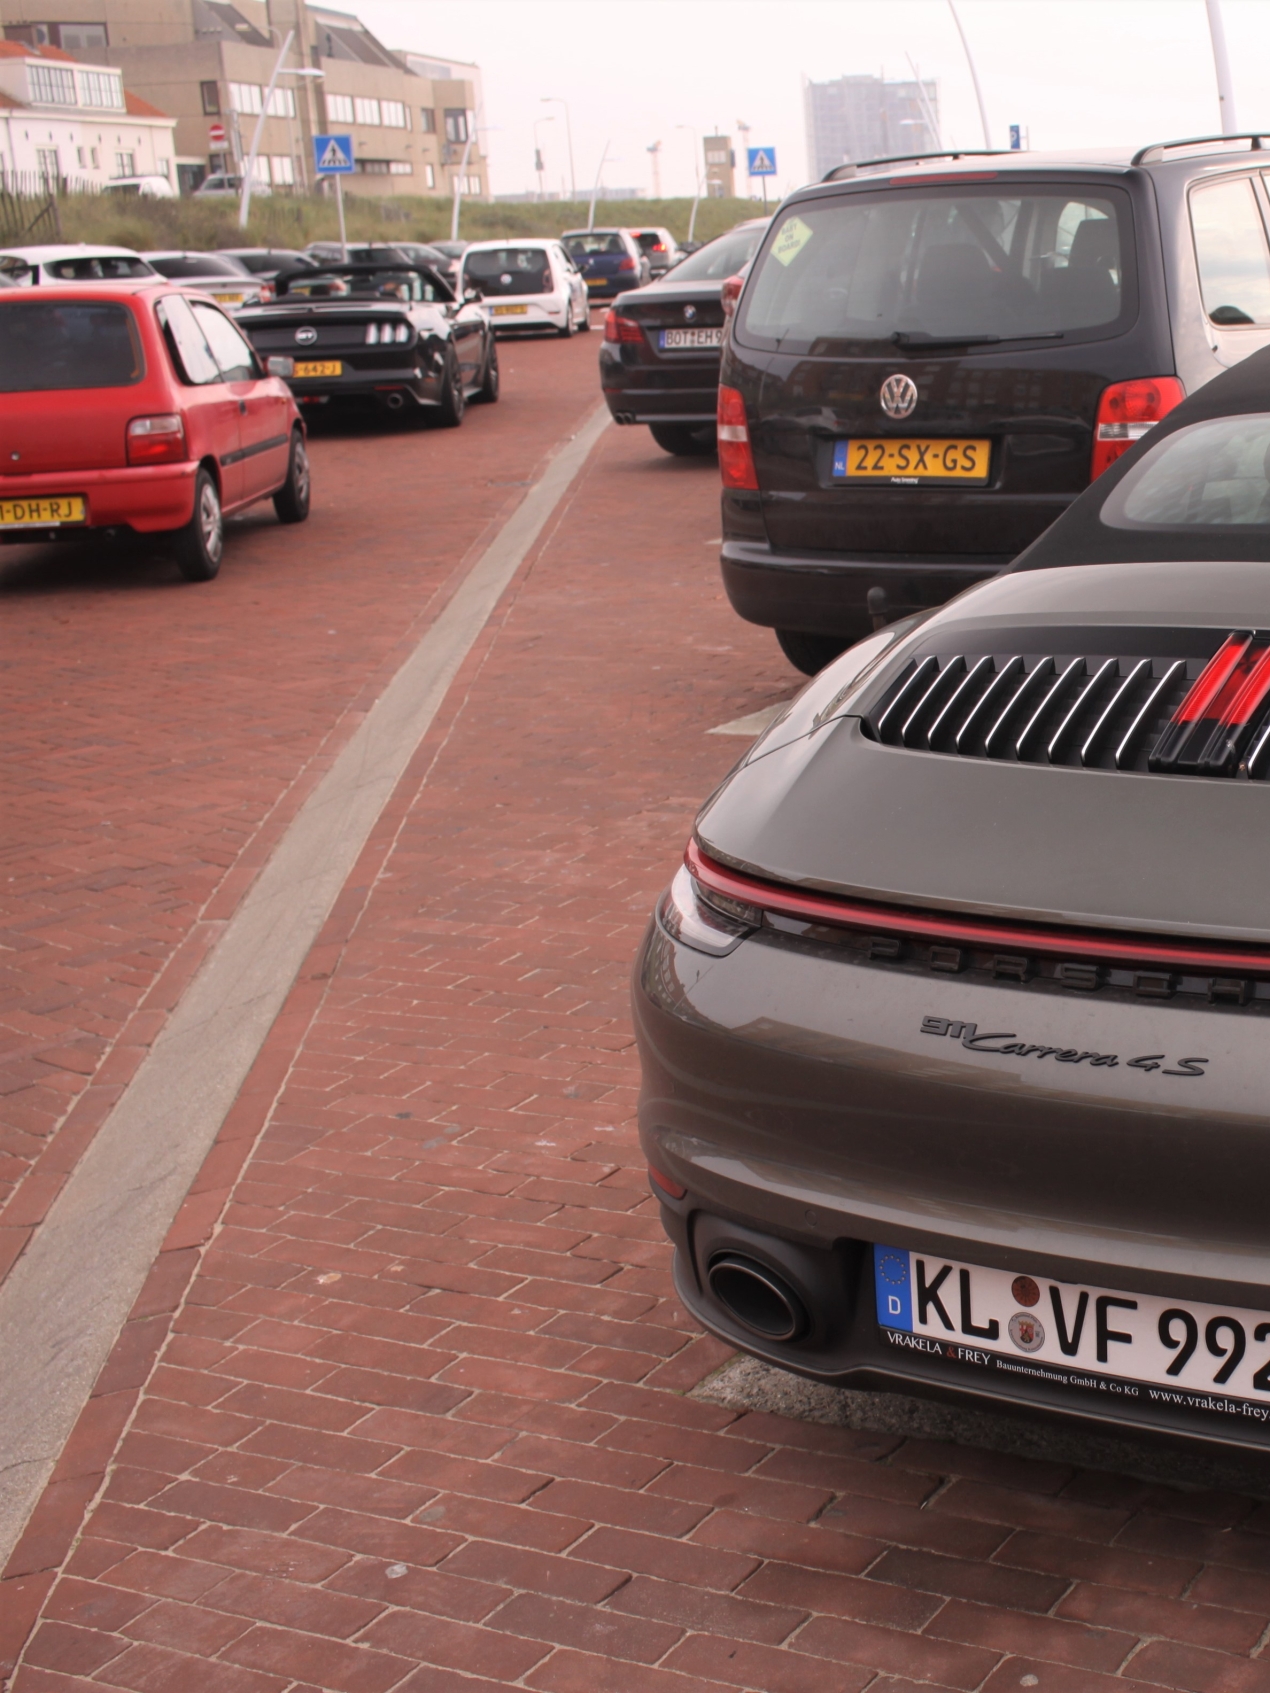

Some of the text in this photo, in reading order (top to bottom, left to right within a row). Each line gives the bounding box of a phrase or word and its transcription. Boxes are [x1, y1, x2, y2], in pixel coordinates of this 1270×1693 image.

[666, 331, 689, 345] BOT
[697, 331, 713, 344] EH
[835, 462, 845, 470] NL
[855, 444, 977, 471] 22-SX-GS
[920, 1015, 978, 1040] 911
[962, 1033, 1119, 1067] Carrera
[888, 1295, 901, 1315] D
[916, 1259, 1000, 1341] KL
[1049, 1285, 1138, 1363] VF
[887, 1331, 943, 1356] VRAKELA
[996, 1359, 1068, 1385] Bauunternehmung
[1070, 1375, 1097, 1389] GmbH
[1100, 1381, 1107, 1390] &
[1110, 1383, 1121, 1393] Co
[1124, 1385, 1139, 1396] KG
